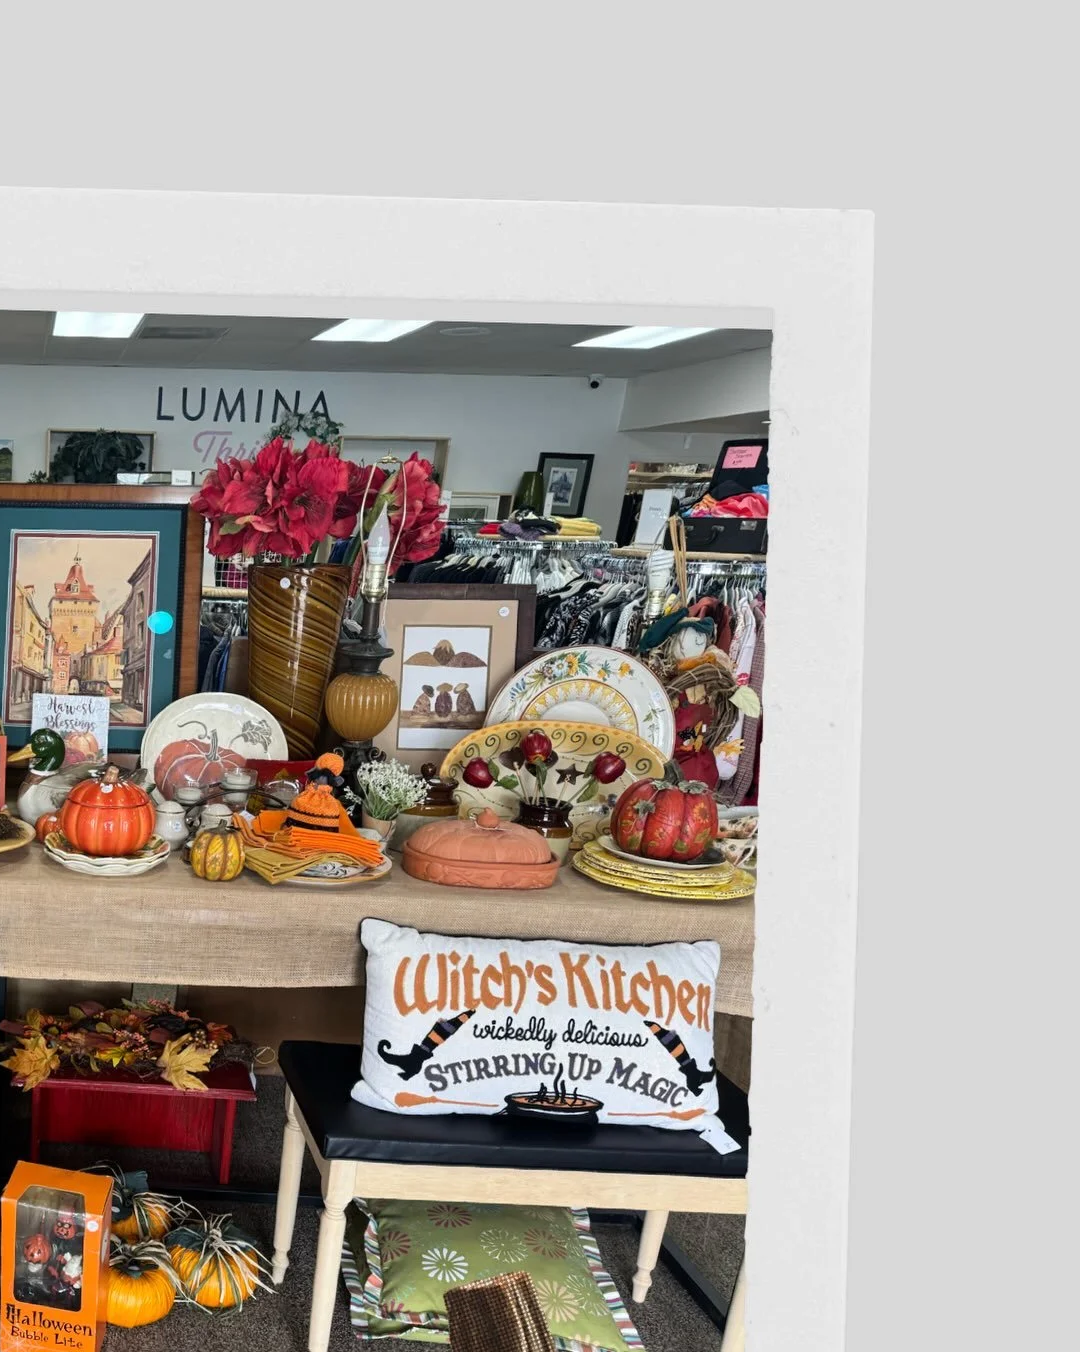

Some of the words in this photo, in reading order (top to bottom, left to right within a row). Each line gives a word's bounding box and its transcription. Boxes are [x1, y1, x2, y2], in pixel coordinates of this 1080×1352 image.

[156, 386, 332, 423] LUMINA
[47, 696, 96, 715] Harvest
[43, 712, 97, 734] Blessings
[393, 950, 558, 1017] Witch's
[558, 952, 712, 1033] Kitchen
[472, 1016, 558, 1050] wickedly
[562, 1018, 649, 1048] delicious
[423, 1052, 557, 1093] STIRRING
[605, 1057, 689, 1108] MAGIC
[6, 1303, 94, 1337] Halloween
[11, 1325, 49, 1343] Bubble
[55, 1333, 83, 1349] Lite
